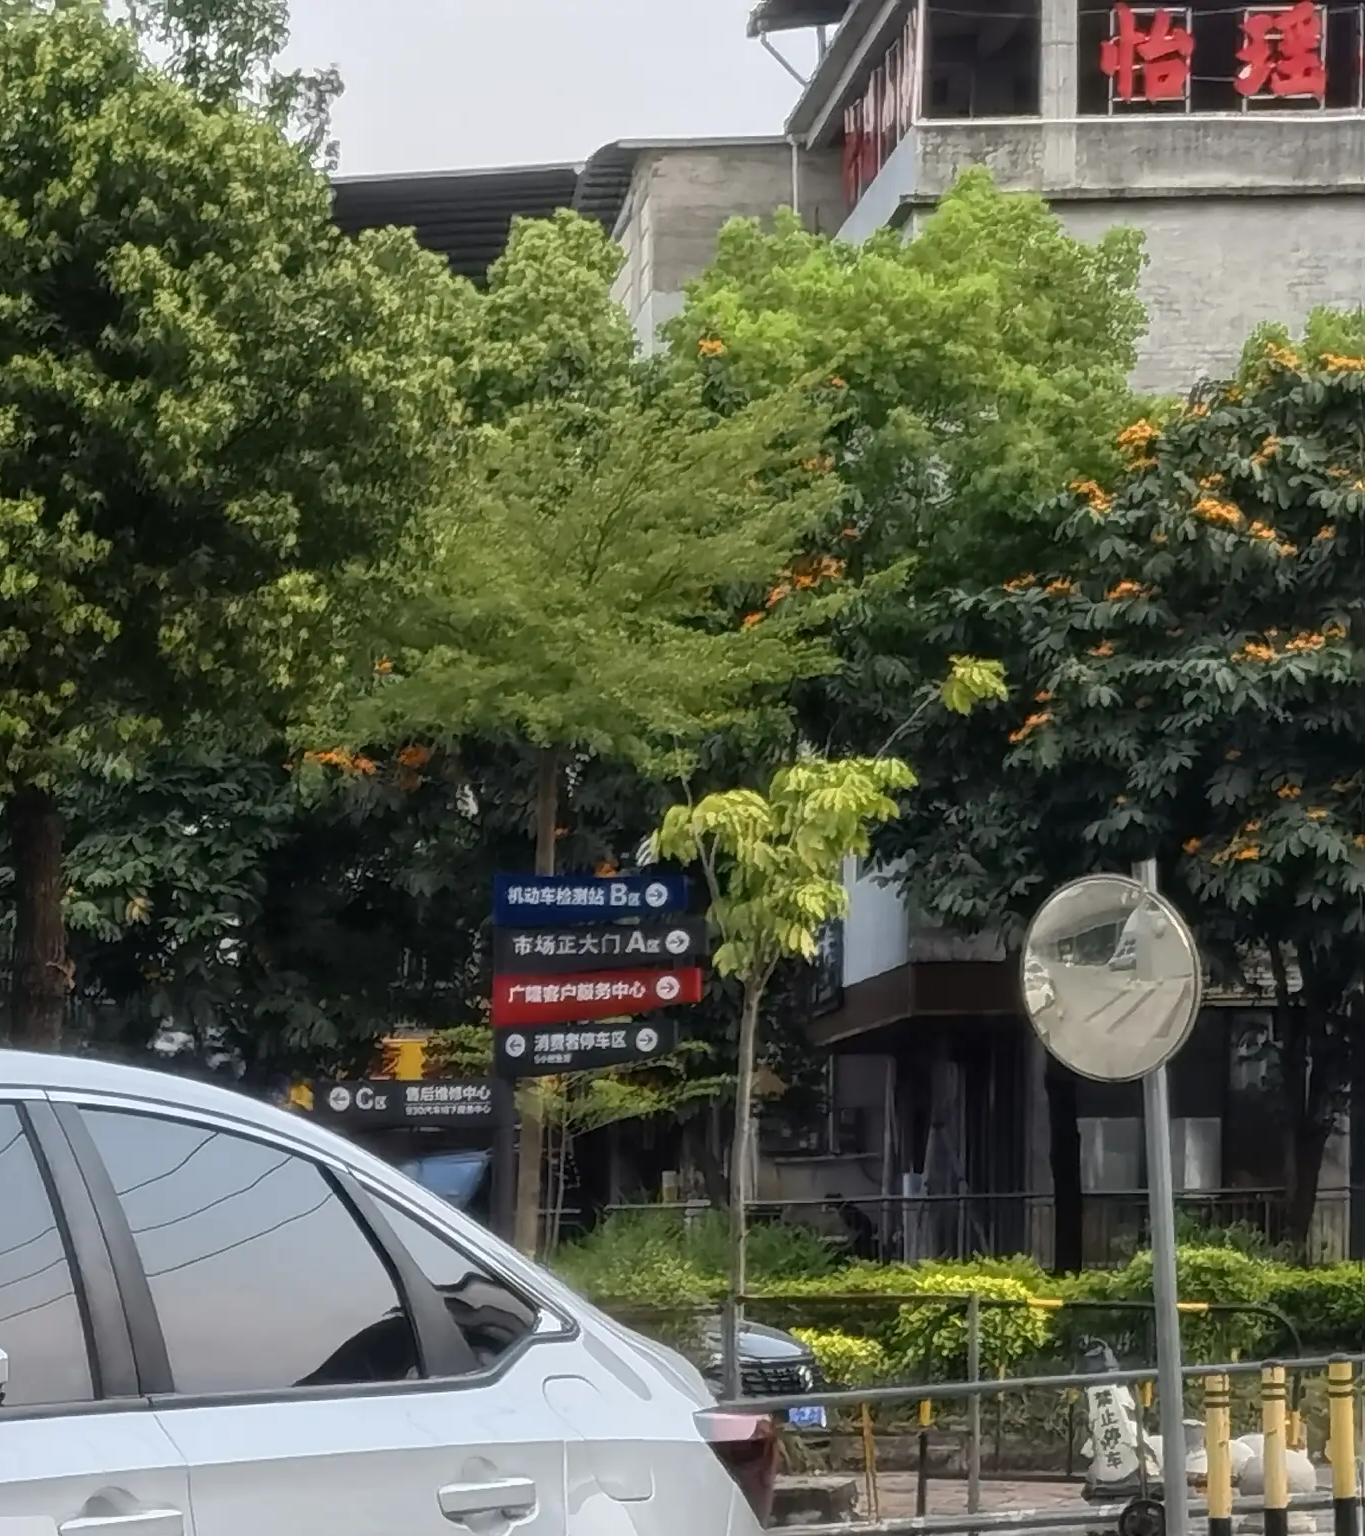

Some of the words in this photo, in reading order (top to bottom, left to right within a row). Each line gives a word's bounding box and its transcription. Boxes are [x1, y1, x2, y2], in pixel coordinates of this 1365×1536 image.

[507, 886, 605, 906] 机动车检测站
[513, 934, 620, 956] 市场正大门
[508, 981, 646, 1003] 广隆客户服务中心
[534, 1030, 627, 1052] 消费者停车区
[1094, 1390, 1123, 1469] 禁止停车
